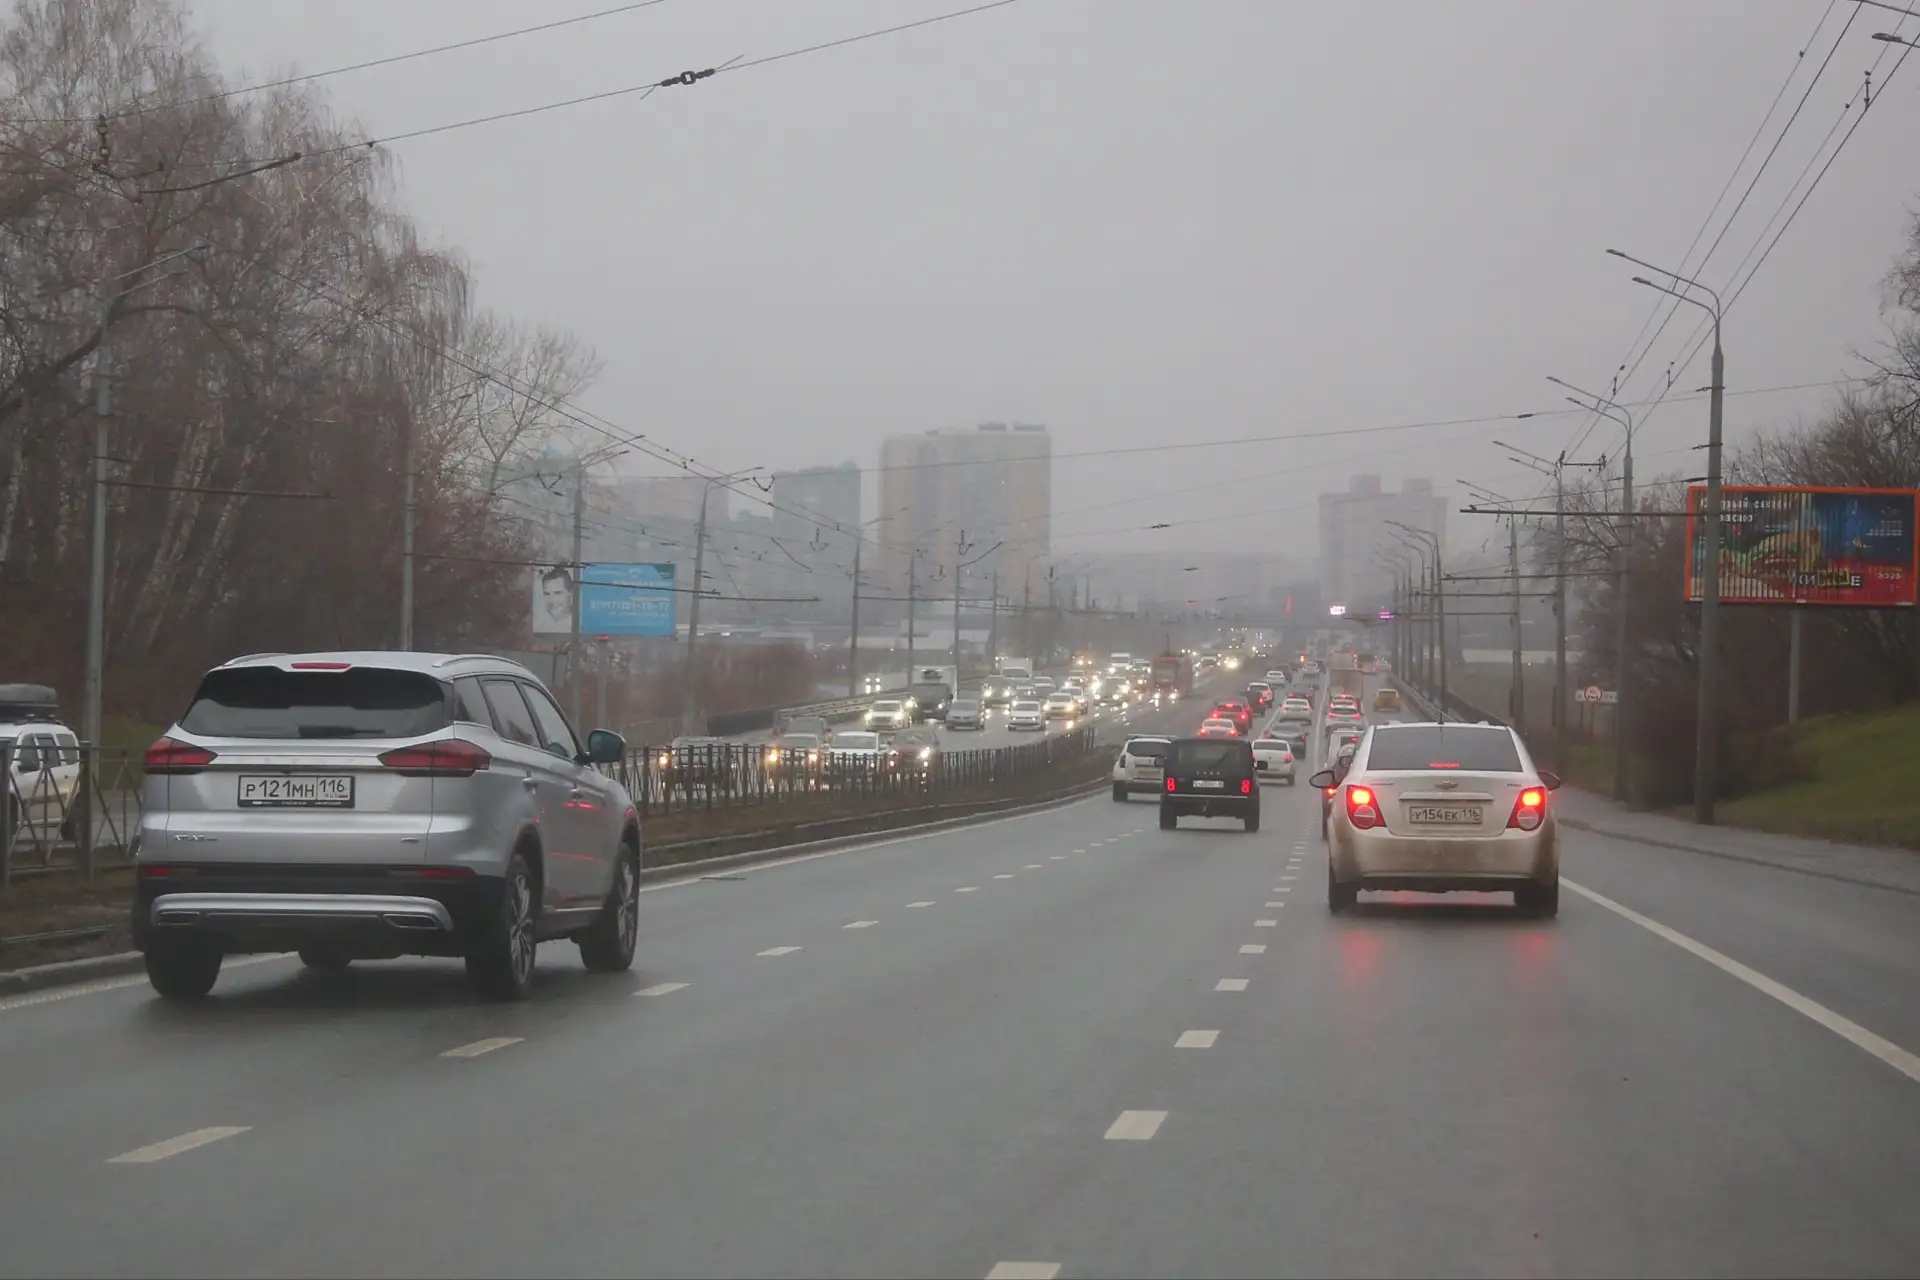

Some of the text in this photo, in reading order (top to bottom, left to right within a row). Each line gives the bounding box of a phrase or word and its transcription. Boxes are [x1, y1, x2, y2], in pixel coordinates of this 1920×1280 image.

[245, 779, 345, 798] Р121МН 116
[1462, 807, 1478, 818] 116
